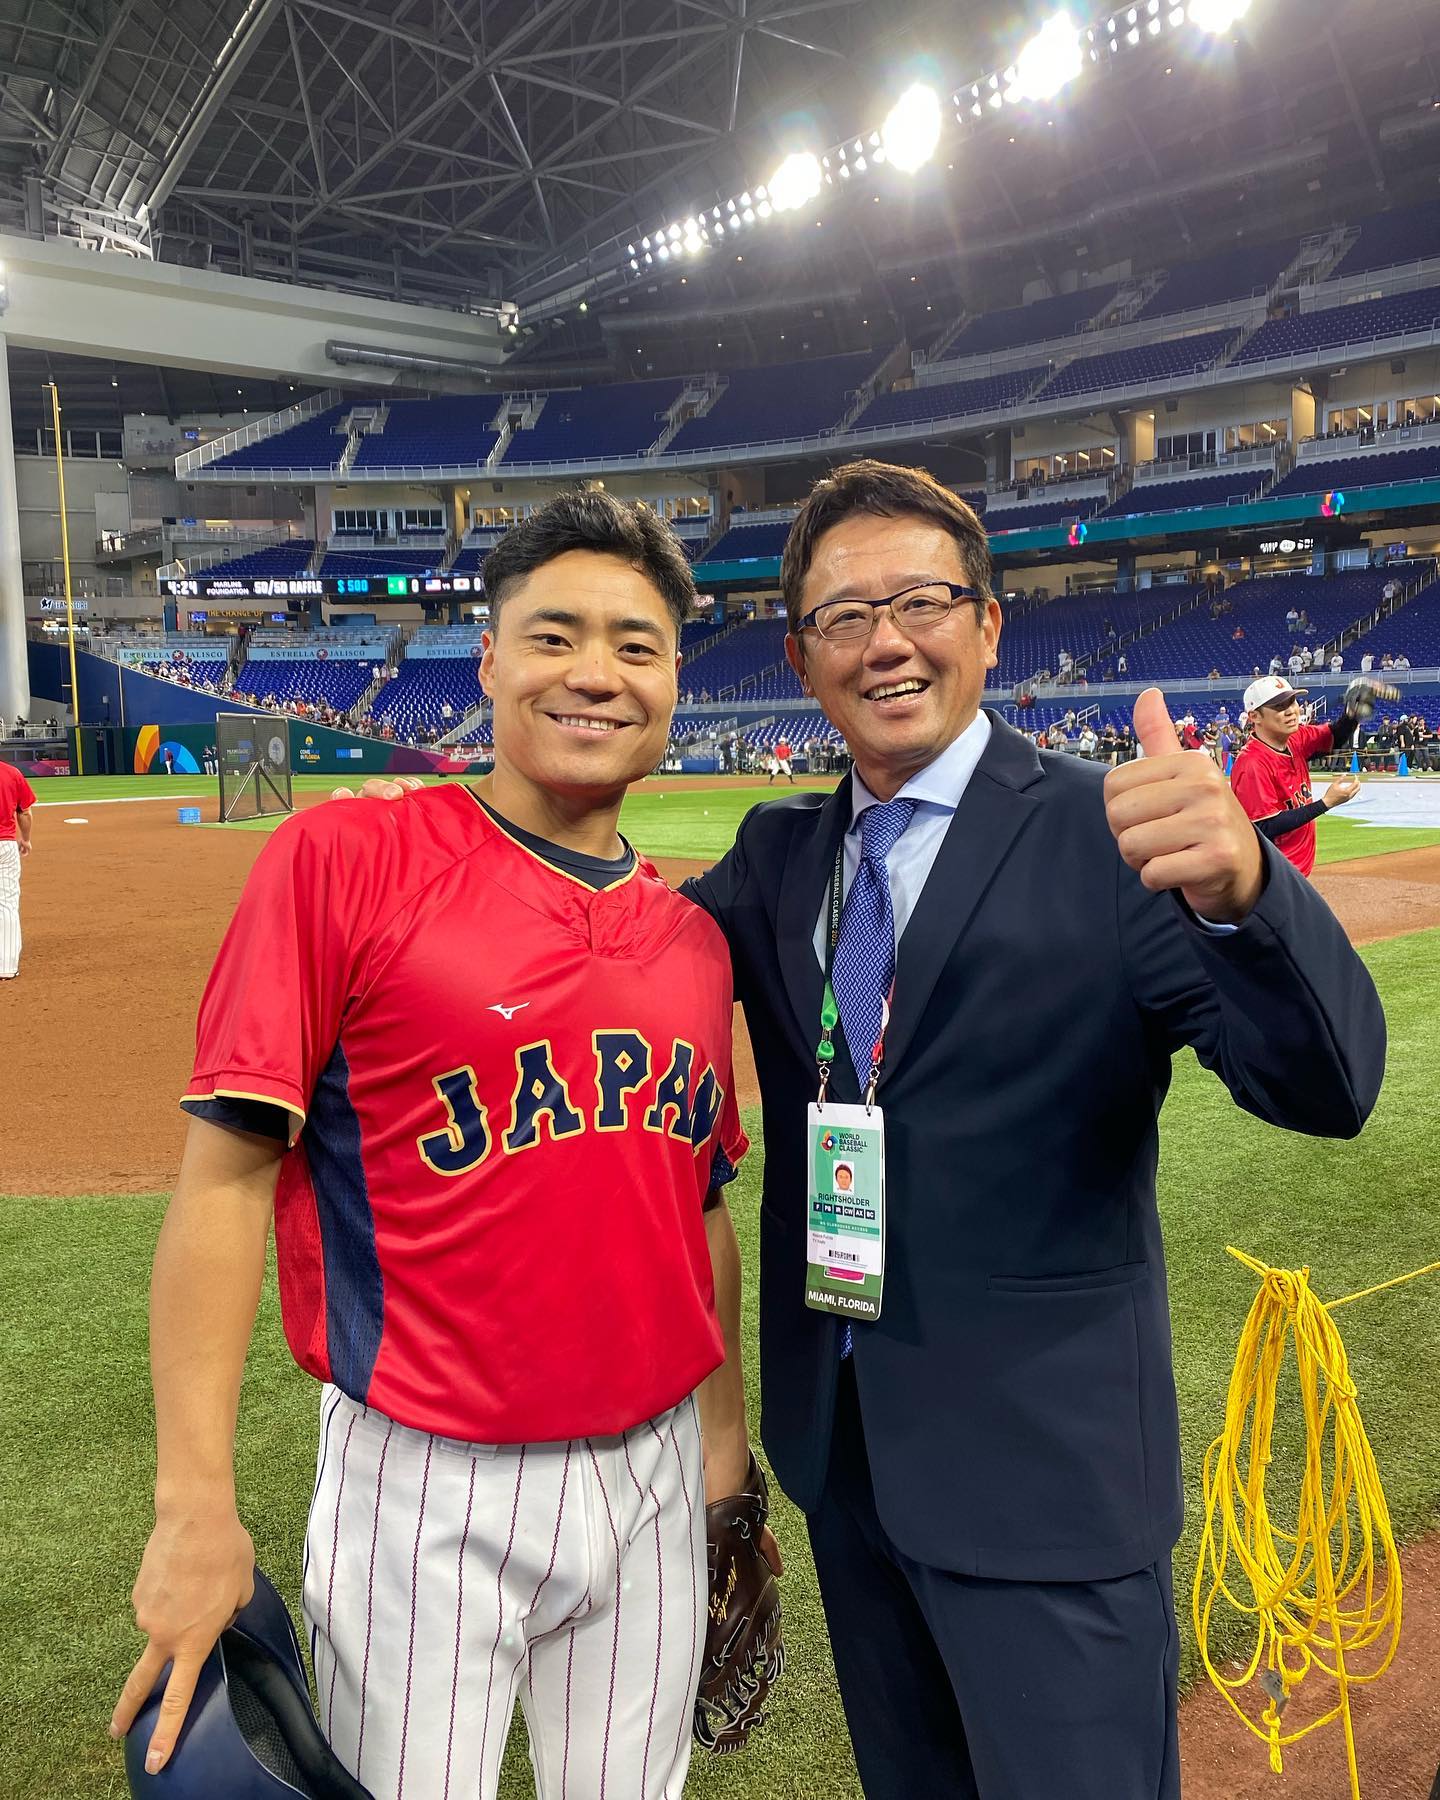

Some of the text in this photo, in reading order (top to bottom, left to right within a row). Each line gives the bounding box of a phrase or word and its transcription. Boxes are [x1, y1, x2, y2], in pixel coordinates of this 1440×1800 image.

[167, 581, 198, 595] 4:24
[254, 580, 323, 596] 50/50 RAFFLE
[337, 579, 369, 593] $ 500
[123, 651, 171, 659] ESTRELLA
[54, 766, 70, 776] 335
[416, 1028, 725, 1177] JAPAN
[838, 1132, 860, 1141] WORLD
[838, 1138, 868, 1148] BASEBALL
[838, 1145, 864, 1153] CLASSIC
[818, 1193, 870, 1206] RIGHTSHOLDER
[808, 1290, 876, 1314] MIAMI, FLORIDA
